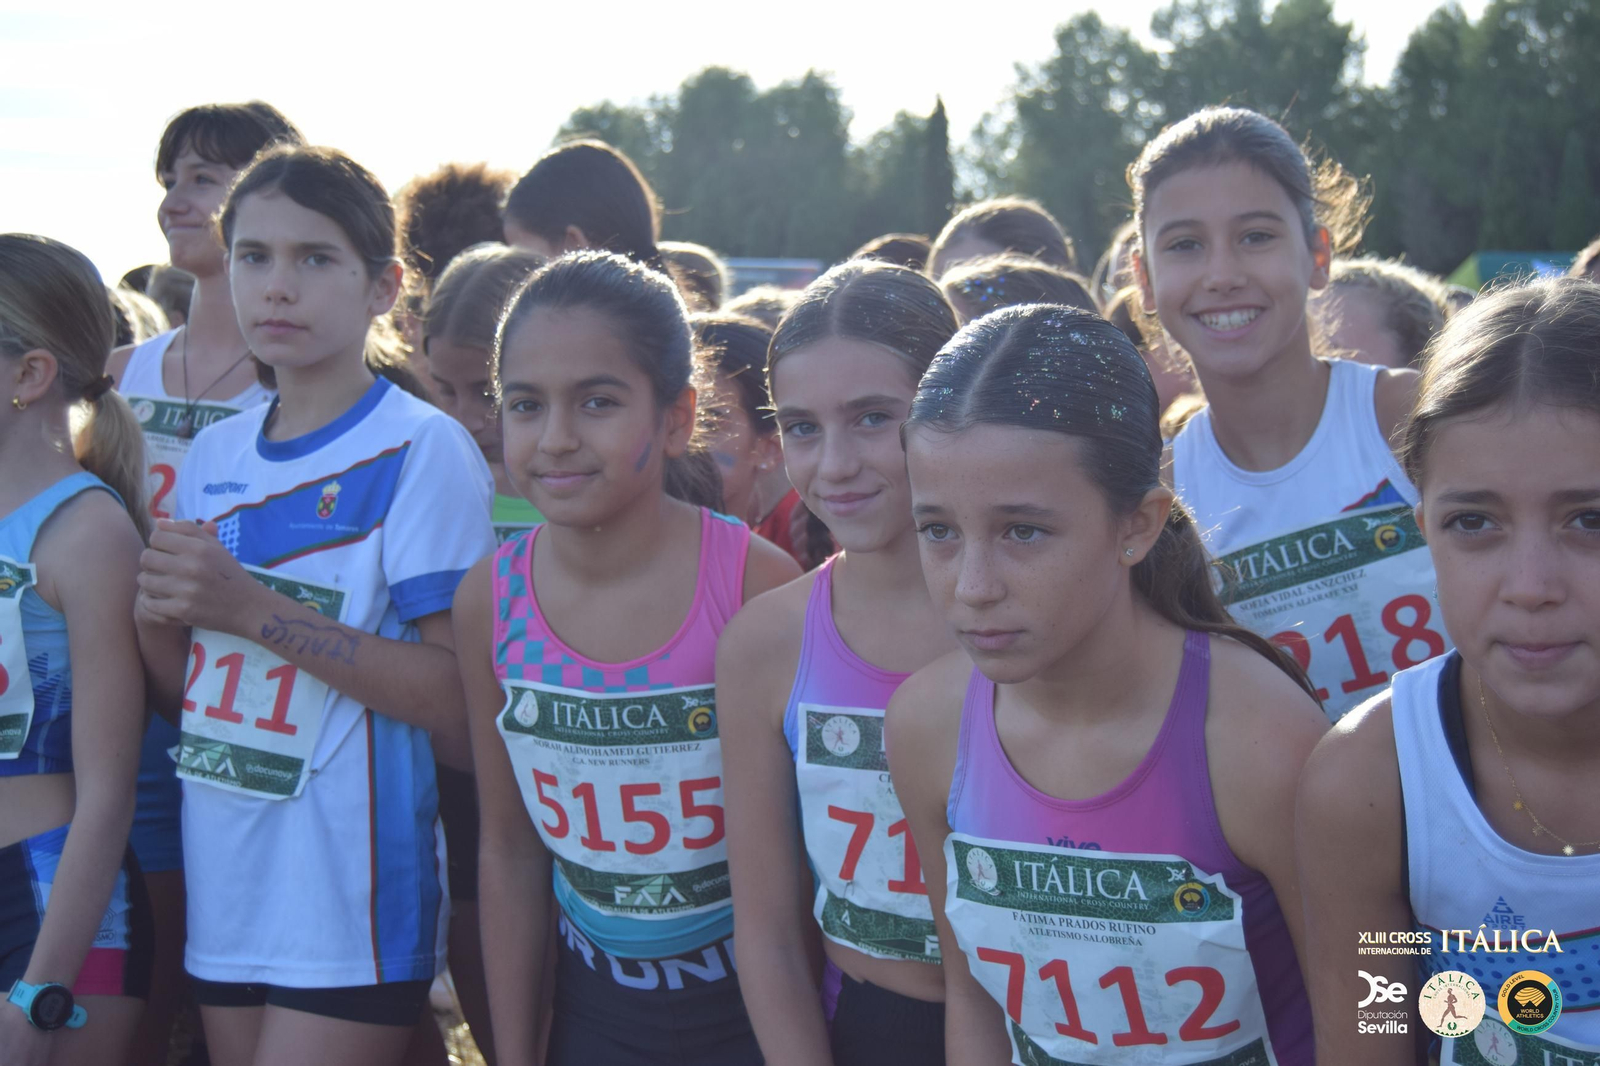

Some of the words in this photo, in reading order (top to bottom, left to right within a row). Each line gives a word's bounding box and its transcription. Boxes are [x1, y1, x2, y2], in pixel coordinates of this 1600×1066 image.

[1232, 528, 1357, 585] ITÁLICA
[1271, 587, 1305, 604] VIDAL
[1306, 568, 1367, 594] SANZCHEZ
[183, 641, 298, 736] 211
[552, 699, 668, 730] ITÁLICA
[533, 738, 562, 751] NORAH
[563, 744, 634, 757] ALIMOHAMED
[636, 743, 701, 756] GUTIERREZ
[588, 759, 607, 767] NEW
[609, 758, 650, 767] RUNNERS
[532, 767, 725, 855] 5155
[1013, 856, 1150, 901] ITÁLICA
[1017, 891, 1078, 905] INTERNATIONAL
[1080, 898, 1106, 906] CROSS
[1108, 901, 1151, 911] COUNTRY
[1012, 910, 1056, 926] FÁTIMA
[1058, 917, 1106, 932] PRADOS
[1108, 921, 1157, 936] RUFINO
[1483, 913, 1526, 926] AIRE
[1028, 927, 1082, 941] ATLETISMO
[1083, 933, 1144, 947] SALOBREÑA
[976, 946, 1241, 1047] 7112
